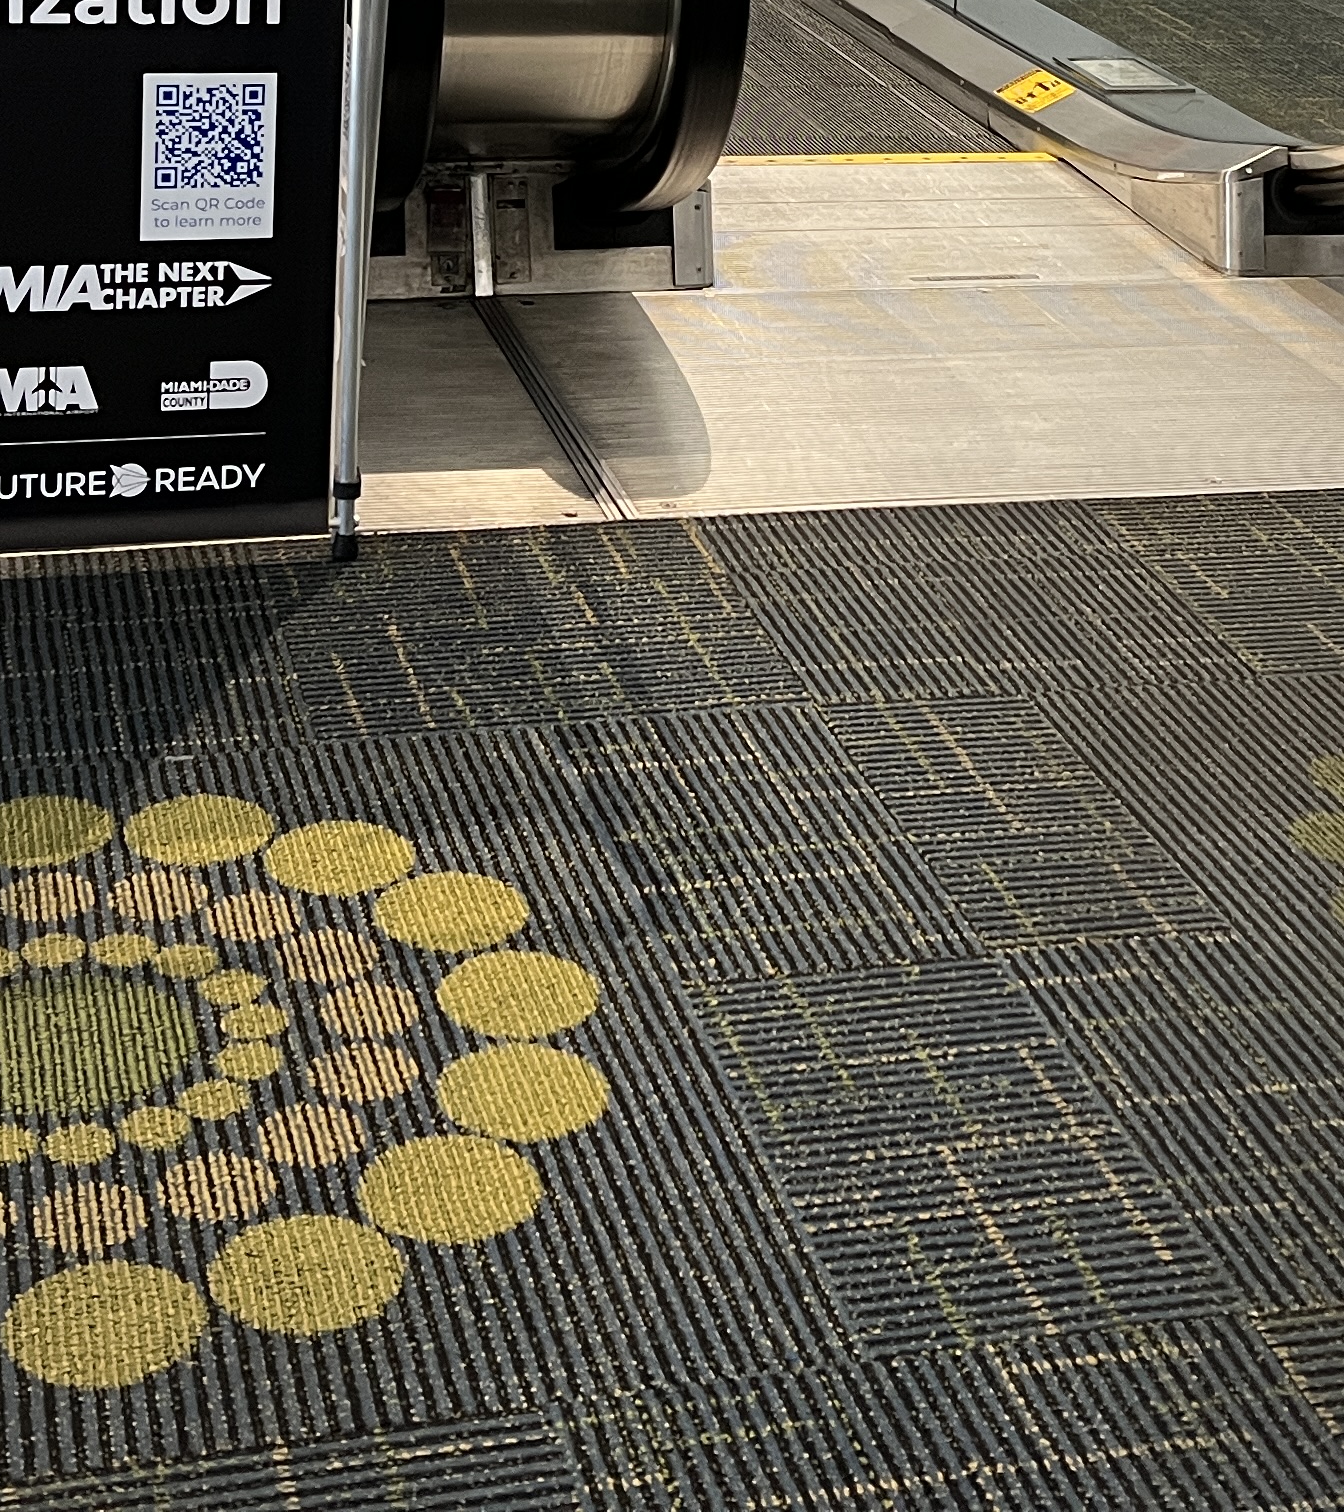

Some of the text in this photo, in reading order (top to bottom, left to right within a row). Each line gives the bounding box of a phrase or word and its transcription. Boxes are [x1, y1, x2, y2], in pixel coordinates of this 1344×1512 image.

[151, 196, 266, 214] Scan QR Code
[154, 214, 262, 229] to learn more
[100, 261, 231, 284] THE NEXT
[100, 286, 227, 310] CHAPTER
[161, 378, 249, 393] MIAMI-DADE
[162, 395, 206, 408] COUNTY
[156, 463, 266, 493] READY
